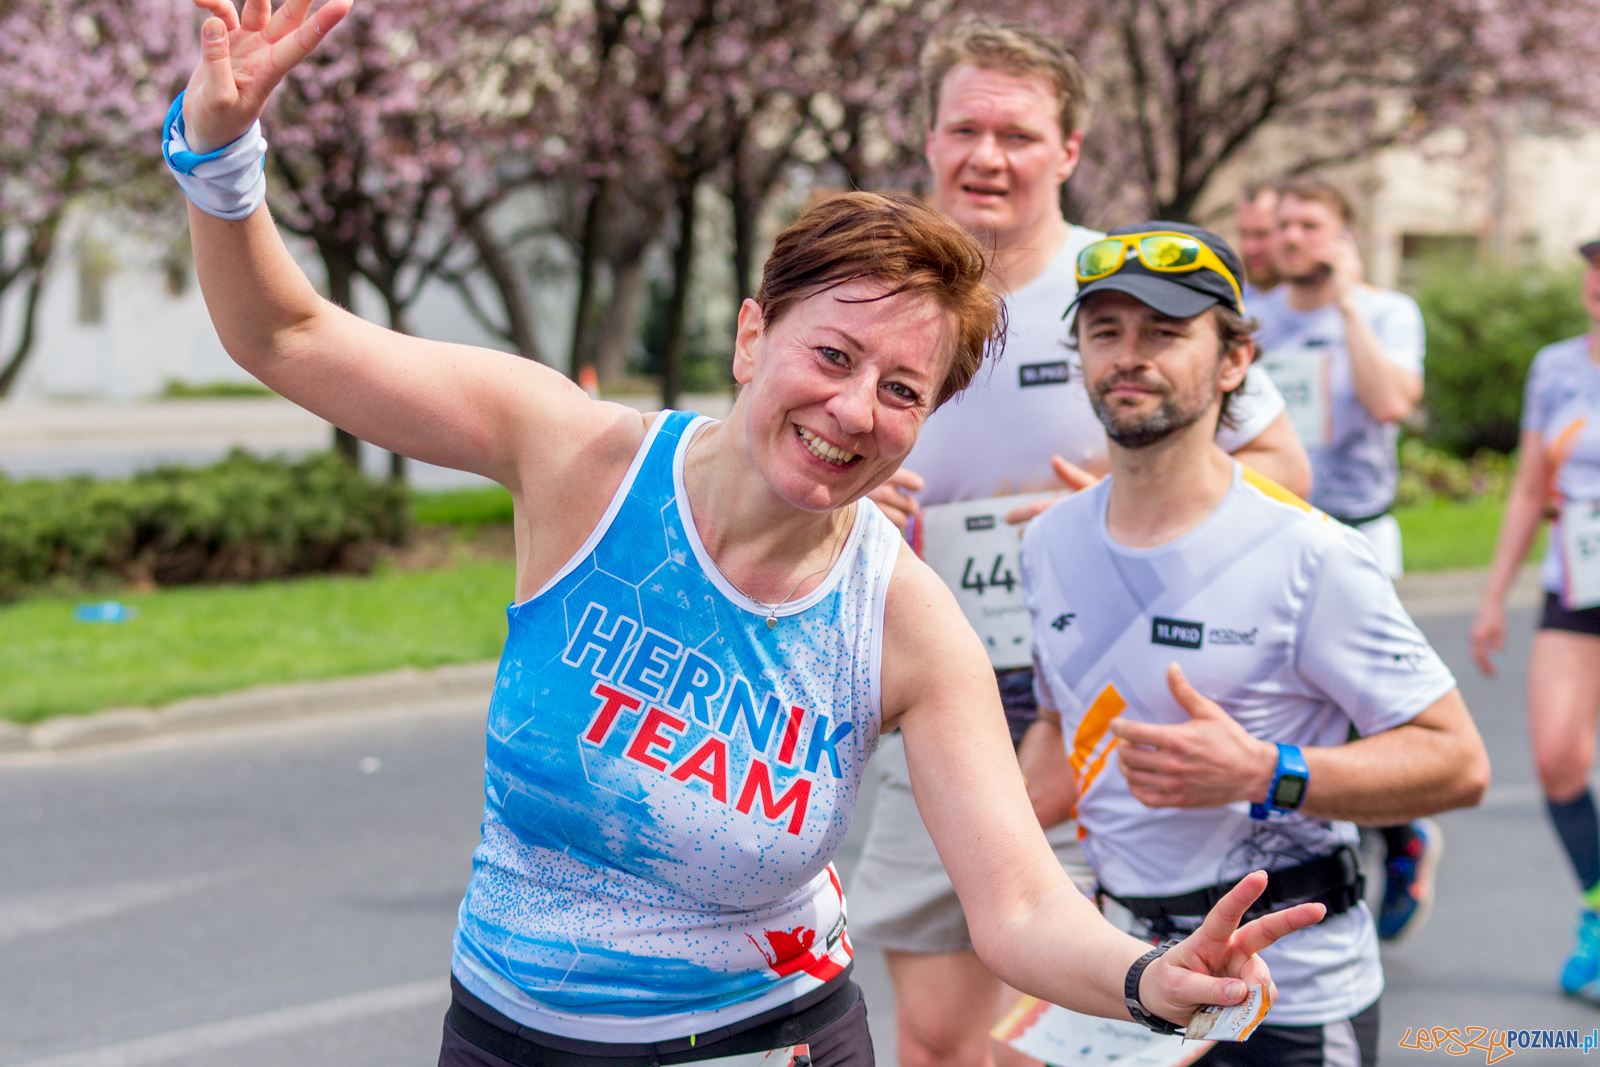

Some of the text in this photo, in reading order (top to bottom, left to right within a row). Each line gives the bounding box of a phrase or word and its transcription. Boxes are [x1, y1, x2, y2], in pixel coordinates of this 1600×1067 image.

[961, 554, 1022, 595] 44
[562, 602, 853, 779] HERNIK
[581, 681, 813, 837] TEAM
